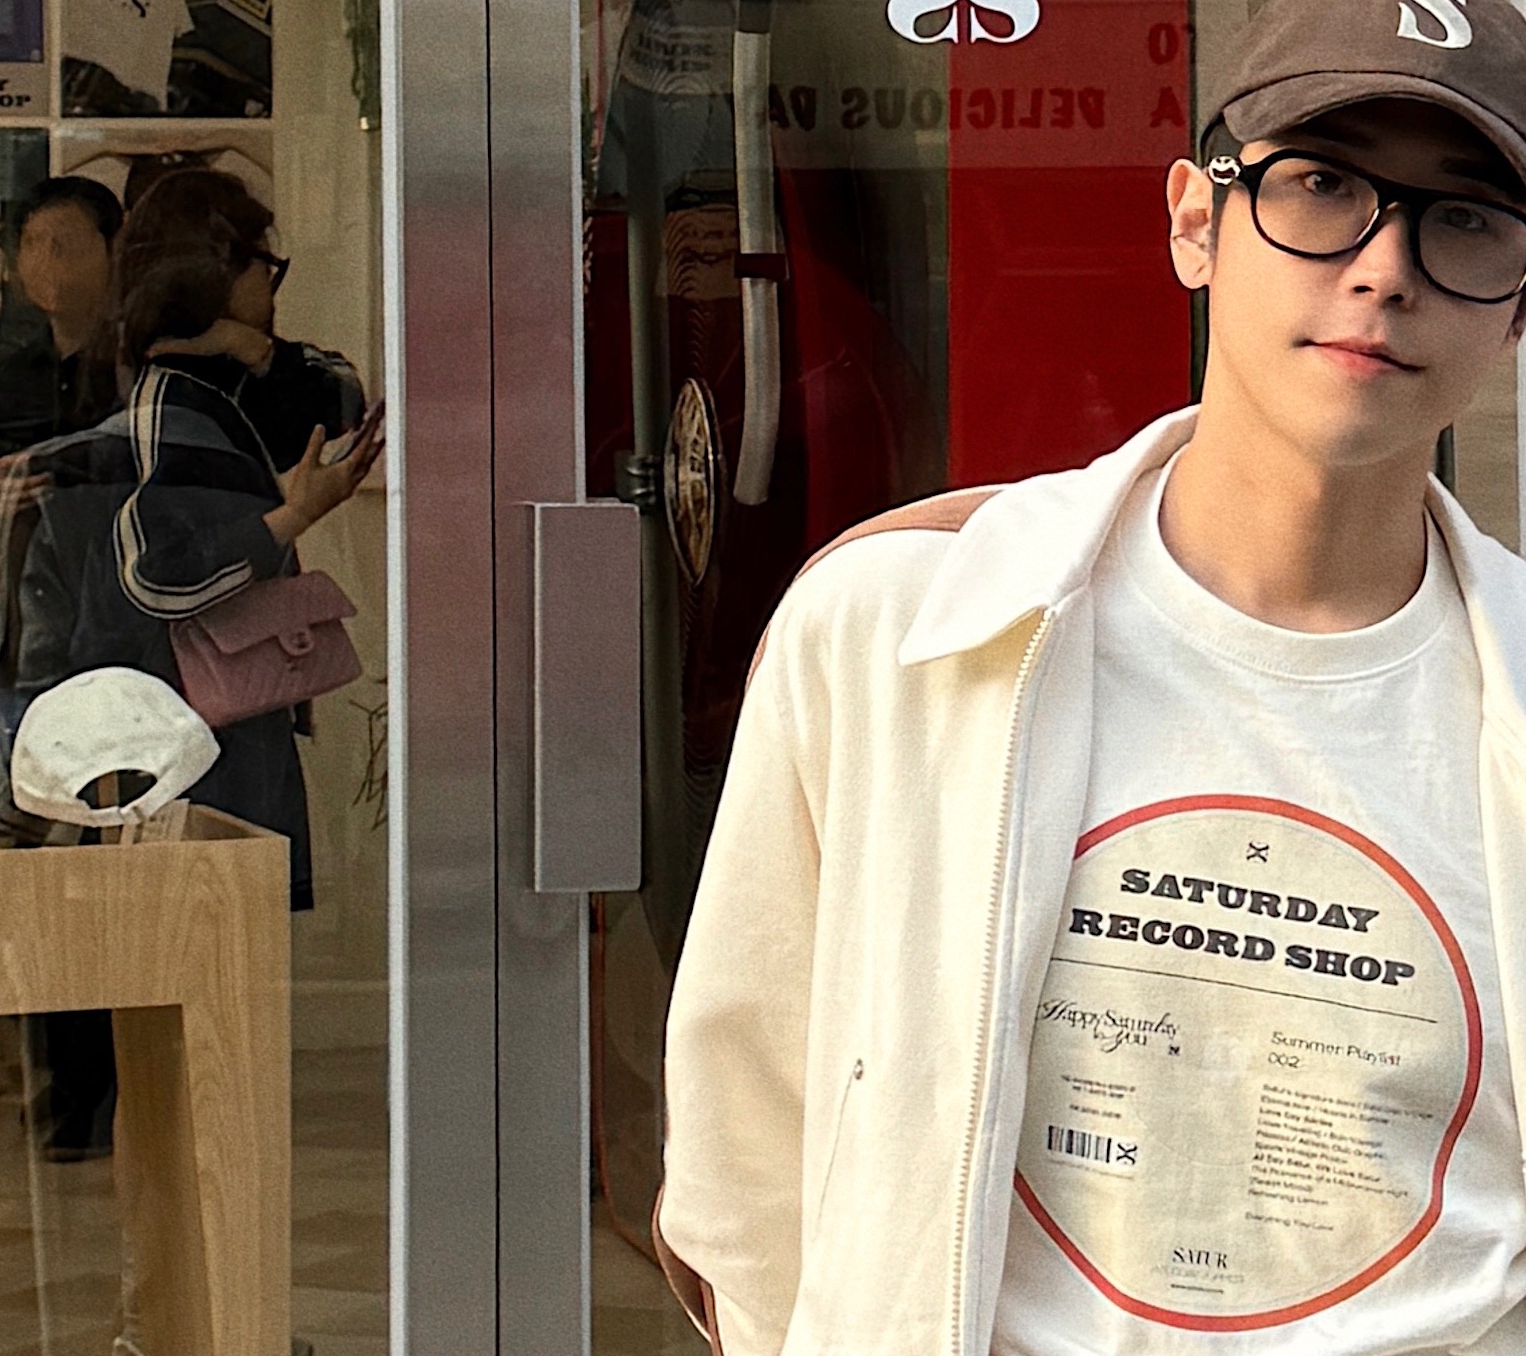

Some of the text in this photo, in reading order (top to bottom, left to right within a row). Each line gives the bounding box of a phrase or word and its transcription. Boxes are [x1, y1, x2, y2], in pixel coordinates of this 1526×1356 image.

[1120, 867, 1379, 934] SATURDAY
[1069, 907, 1416, 986] RECORD SHOP
[1268, 1052, 1300, 1068] 002
[1271, 1031, 1343, 1056] Summer
